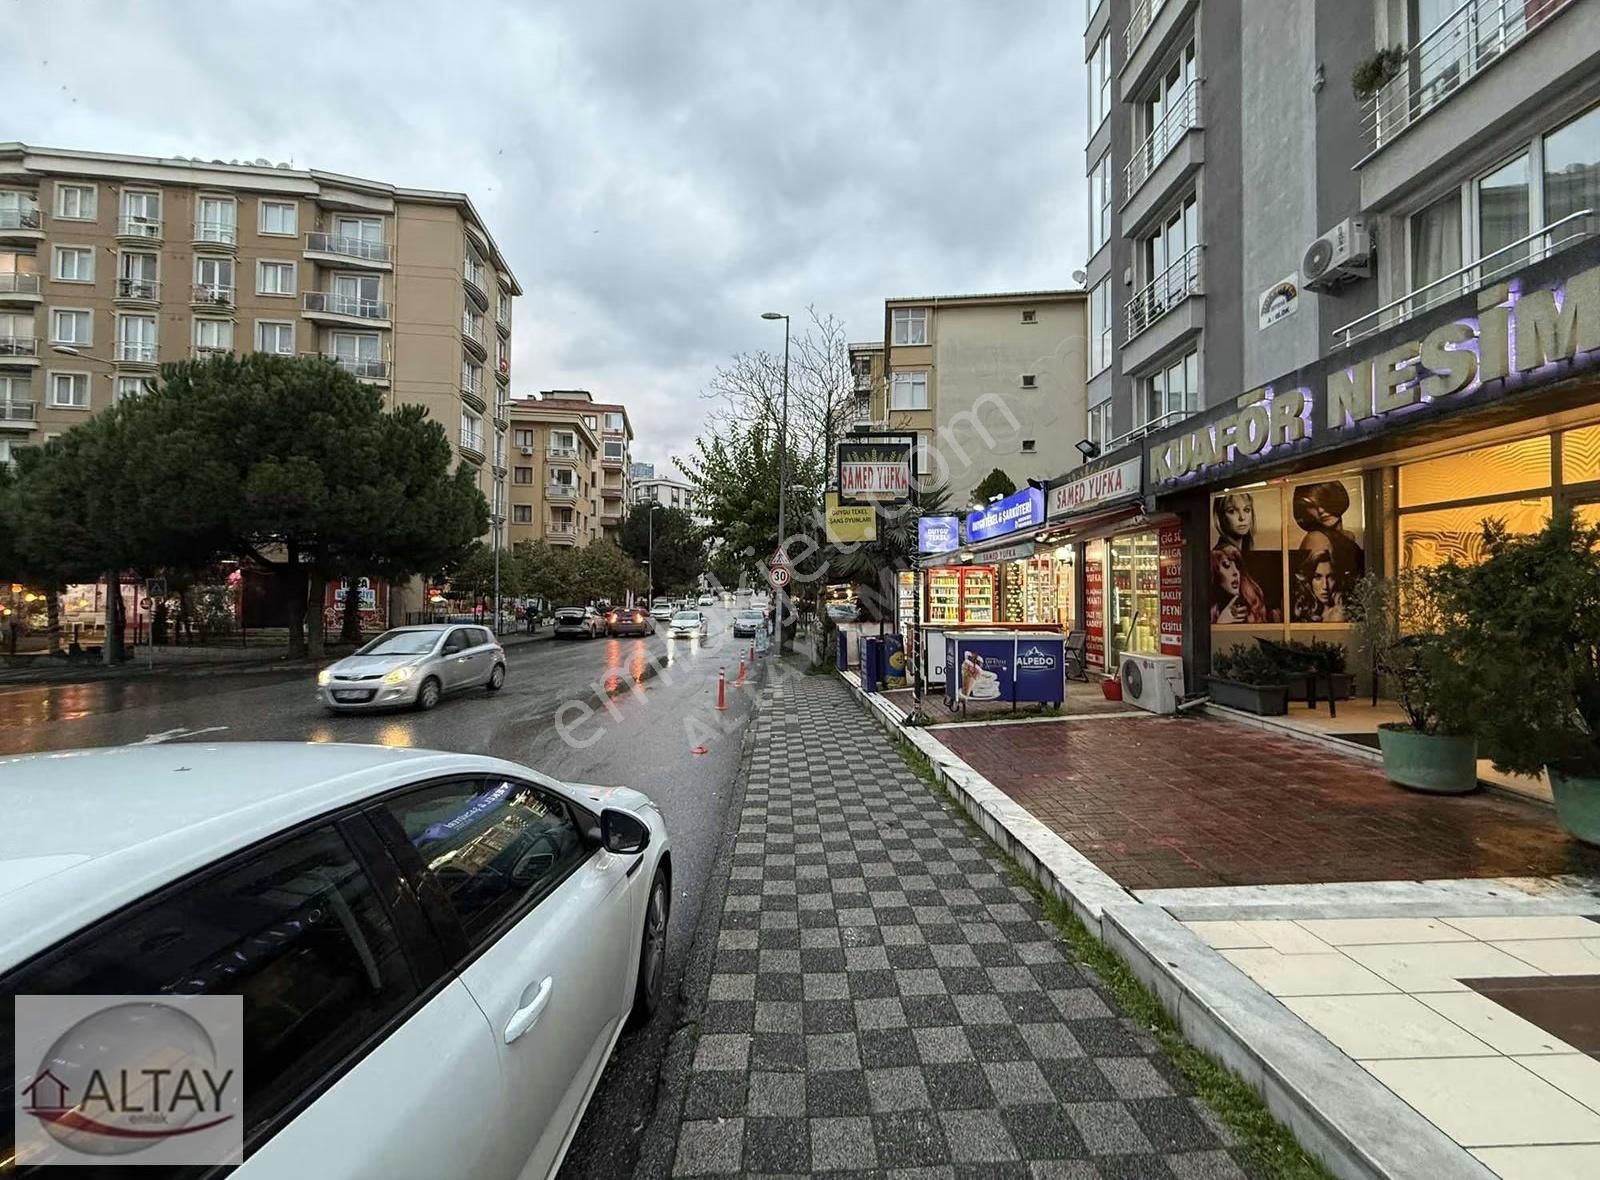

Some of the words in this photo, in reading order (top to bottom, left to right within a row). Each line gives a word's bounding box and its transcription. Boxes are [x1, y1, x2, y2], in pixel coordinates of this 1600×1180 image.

[842, 465, 874, 490] SAMED
[877, 465, 908, 490] YUFKA
[1056, 482, 1085, 509] SAMED
[1088, 469, 1122, 499] YUFKA
[1000, 548, 1016, 558] YUFKA
[774, 571, 786, 581] 30
[1016, 657, 1054, 666] ALPEDO
